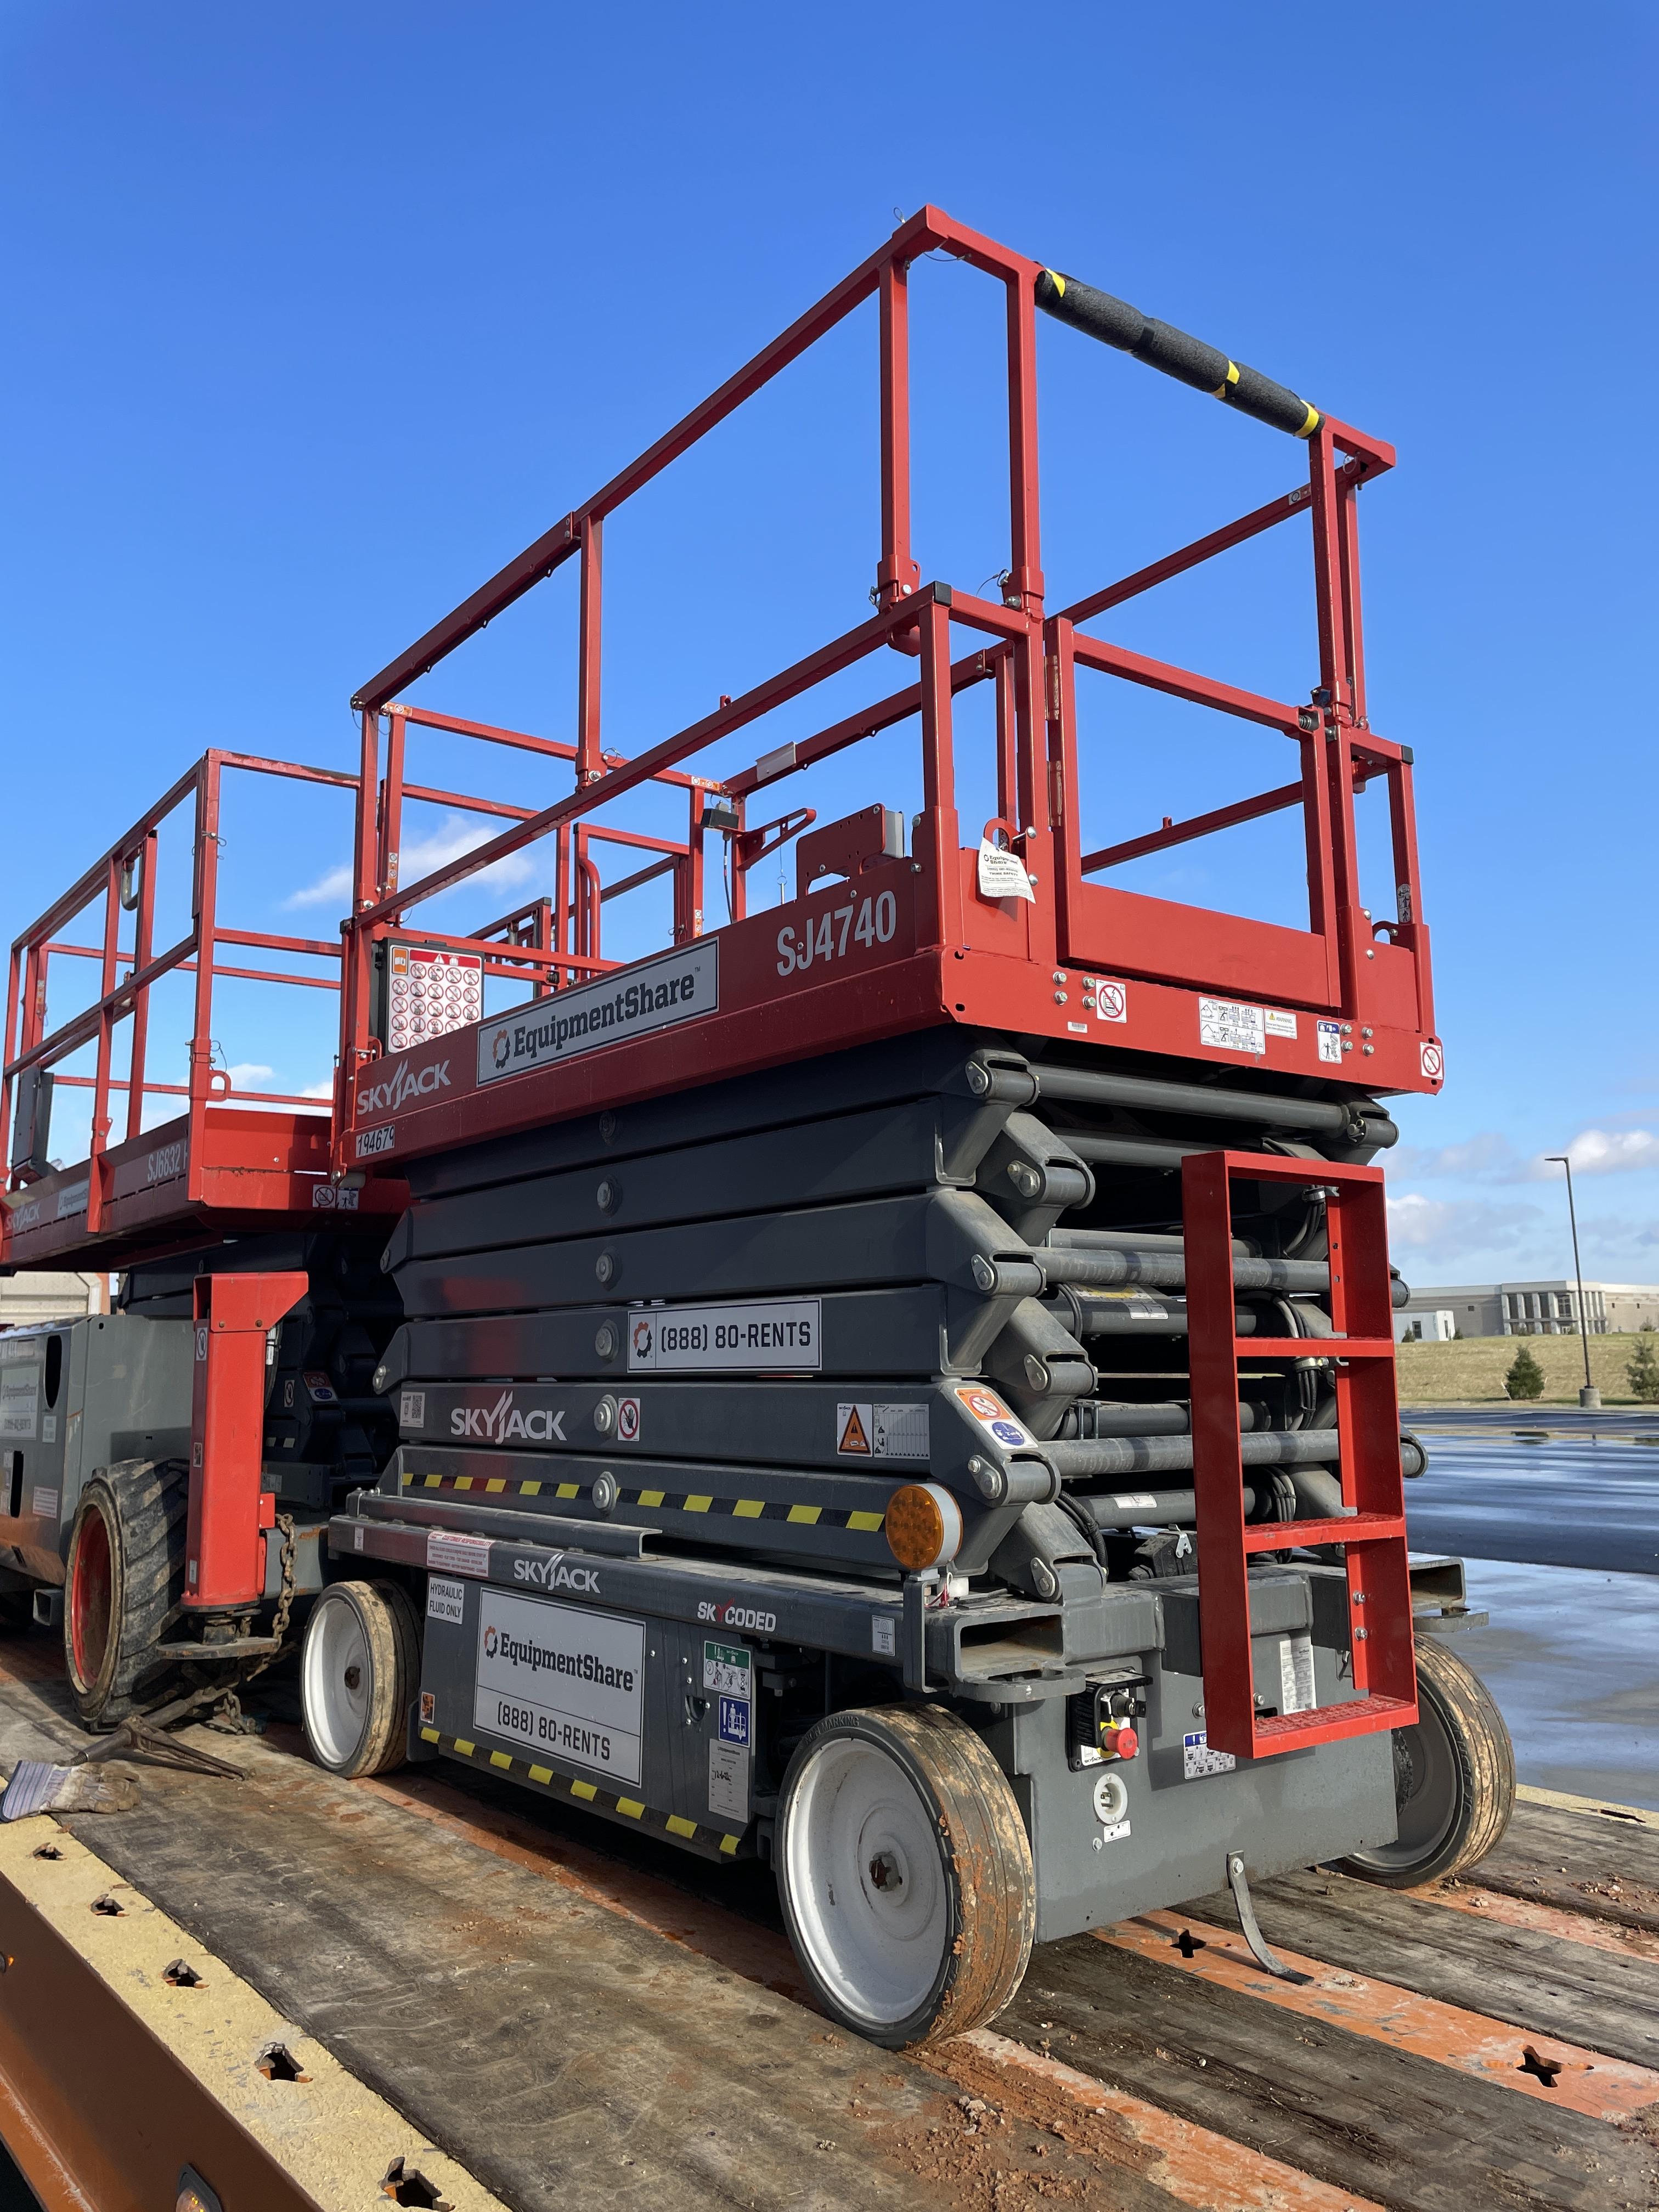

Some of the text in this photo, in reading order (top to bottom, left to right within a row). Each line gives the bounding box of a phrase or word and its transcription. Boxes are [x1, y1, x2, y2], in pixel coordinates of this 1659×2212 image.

[777, 890, 897, 977] SJ4740
[357, 1058, 452, 1115] SKYJACK
[358, 1125, 394, 1156] 194679
[147, 1143, 182, 1183] SJ6832
[5, 1201, 40, 1231] SKYJACK
[661, 1321, 811, 1353] (888) 80-RENTS
[450, 1390, 568, 1445] SKYJACK
[514, 1553, 601, 1594] SKYJACK
[429, 1600, 461, 1618] FLUID ONLY
[430, 1582, 462, 1601] HYDRAULIC
[697, 1597, 777, 1632] SKYCODED
[498, 1701, 611, 1760] (888) 80-RENTS
[821, 1715, 860, 1730] MARKING
